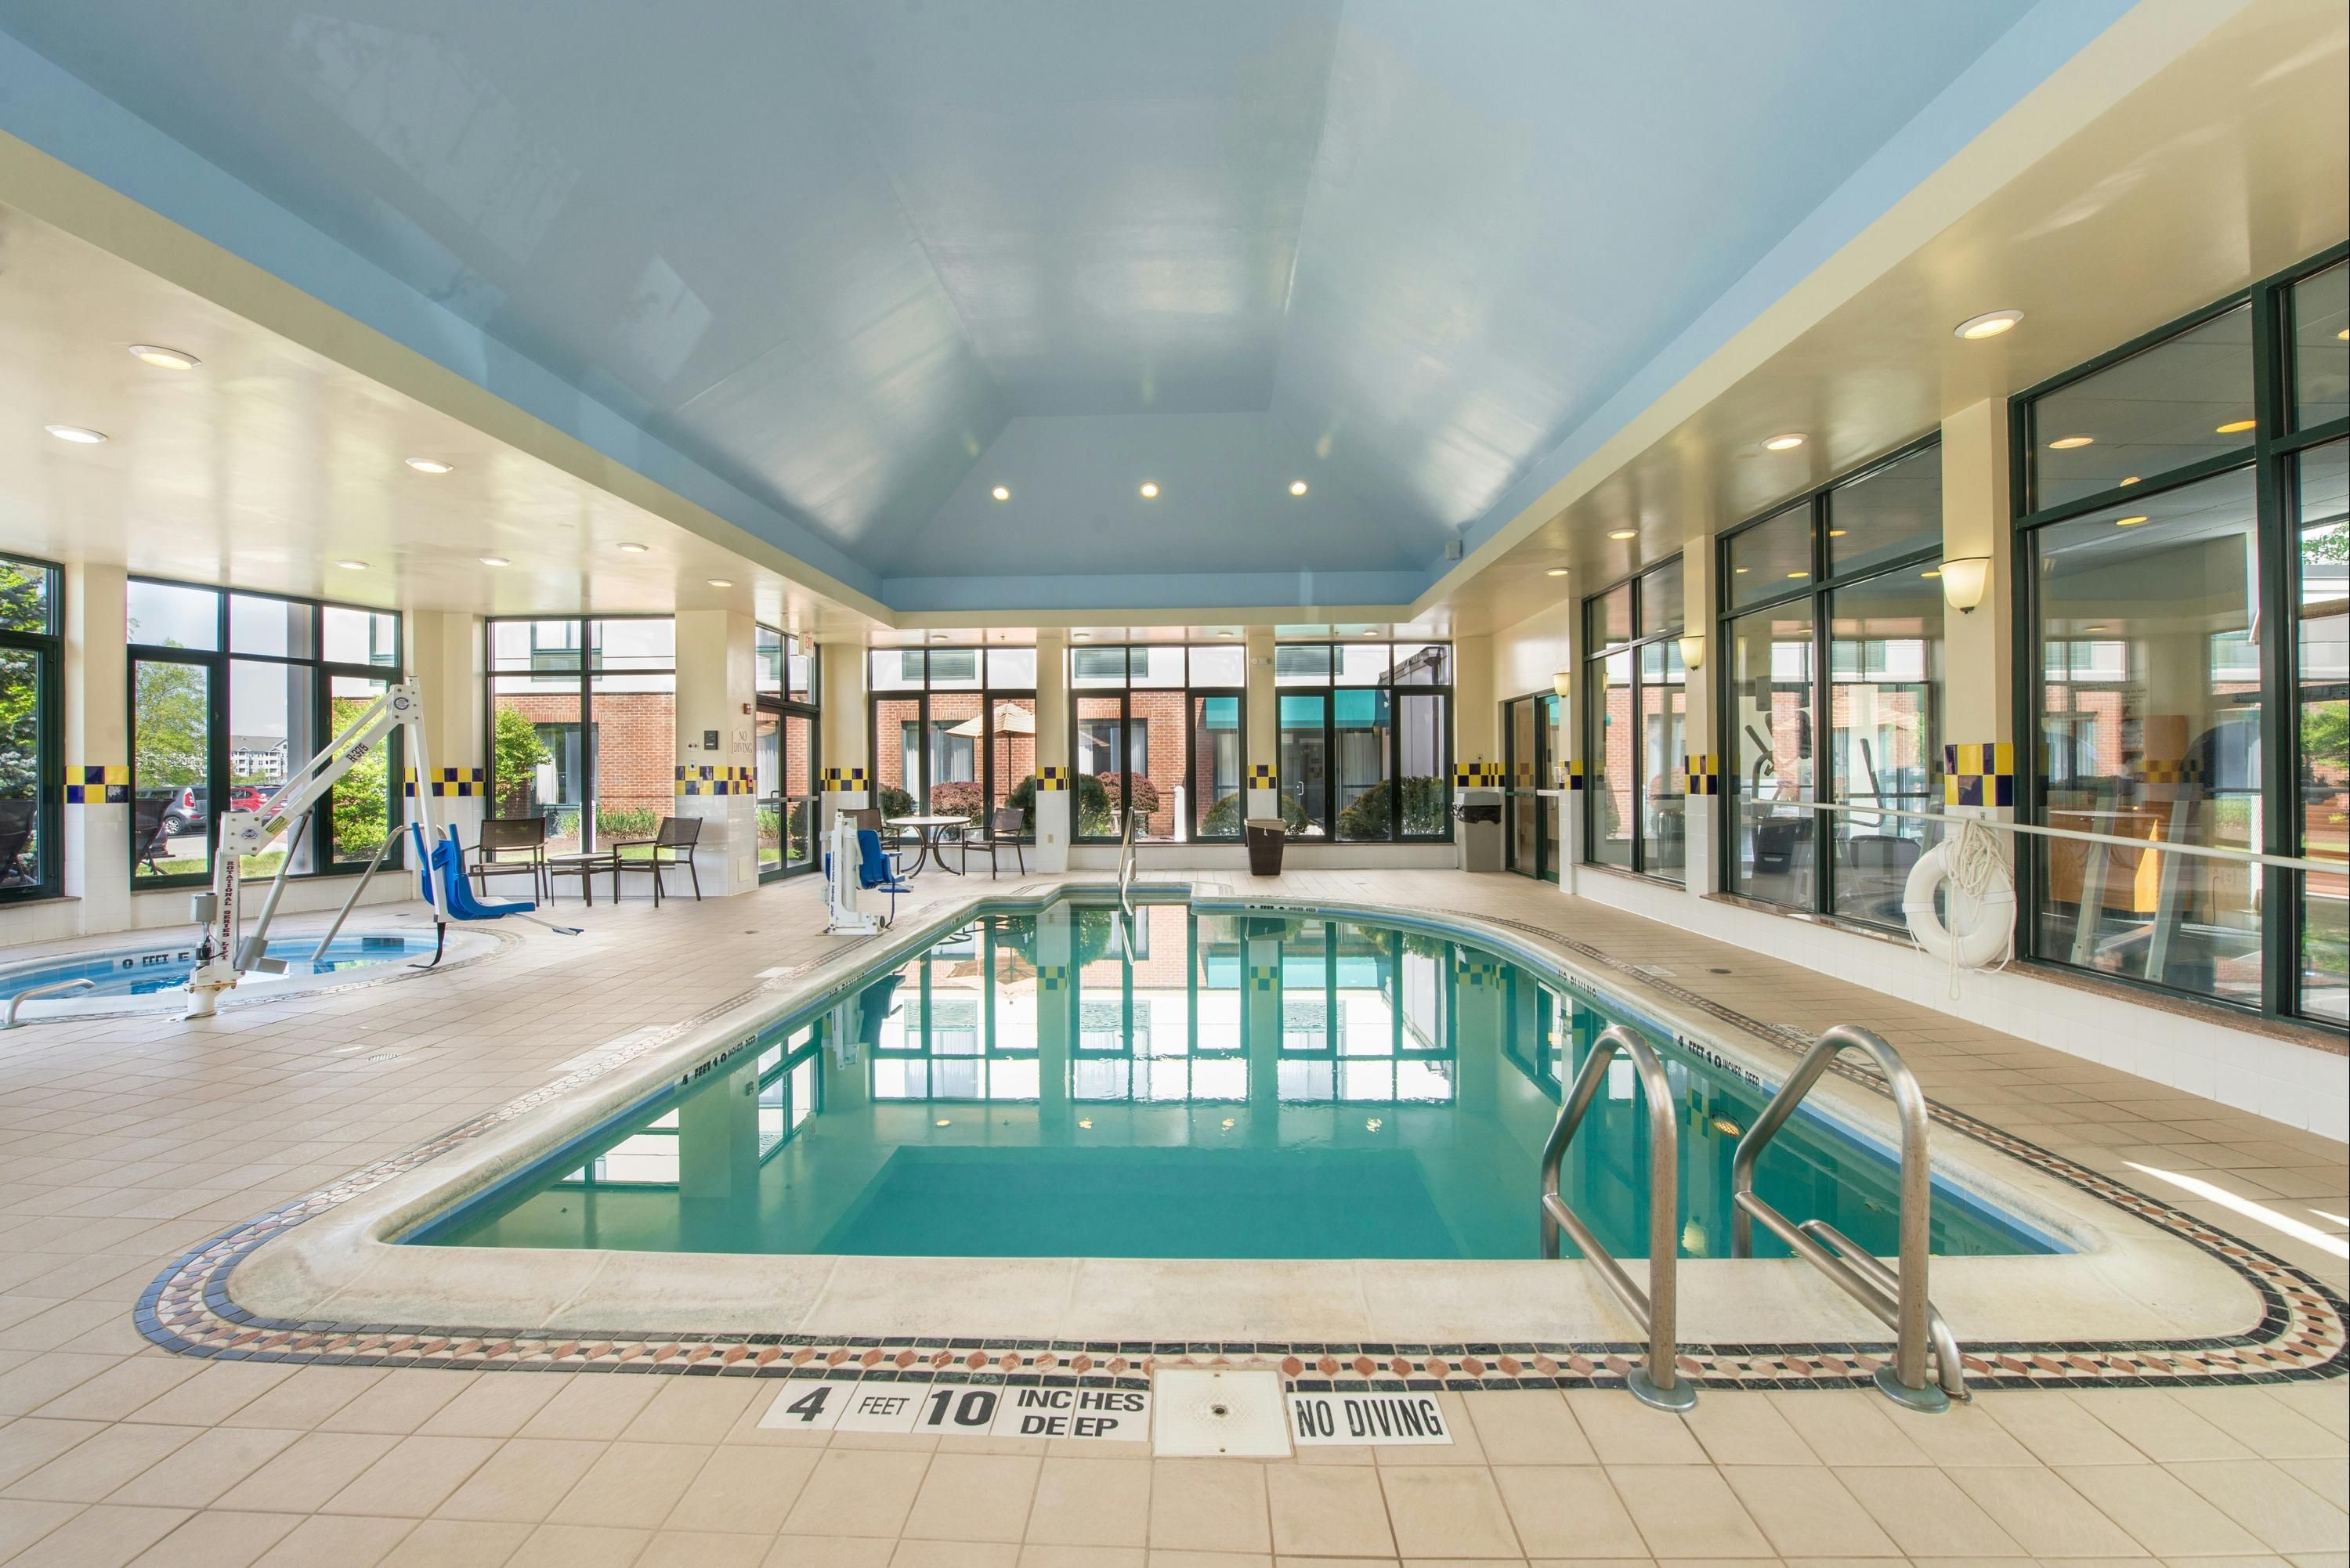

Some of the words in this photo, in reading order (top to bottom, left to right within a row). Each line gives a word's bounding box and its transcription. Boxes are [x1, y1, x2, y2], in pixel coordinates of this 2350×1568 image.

[734, 742, 752, 753] DIVING
[739, 731, 747, 741] NO
[224, 861, 234, 905] ROTATIONAL
[222, 910, 232, 937] SERIES
[1689, 1040, 1705, 1057] FEET
[1723, 1059, 1741, 1077] INCHES
[786, 1386, 833, 1422] 4
[858, 1396, 910, 1415] FEET
[927, 1390, 997, 1426] 10
[1295, 1400, 1335, 1437] NO
[1344, 1399, 1444, 1437] DIVING
